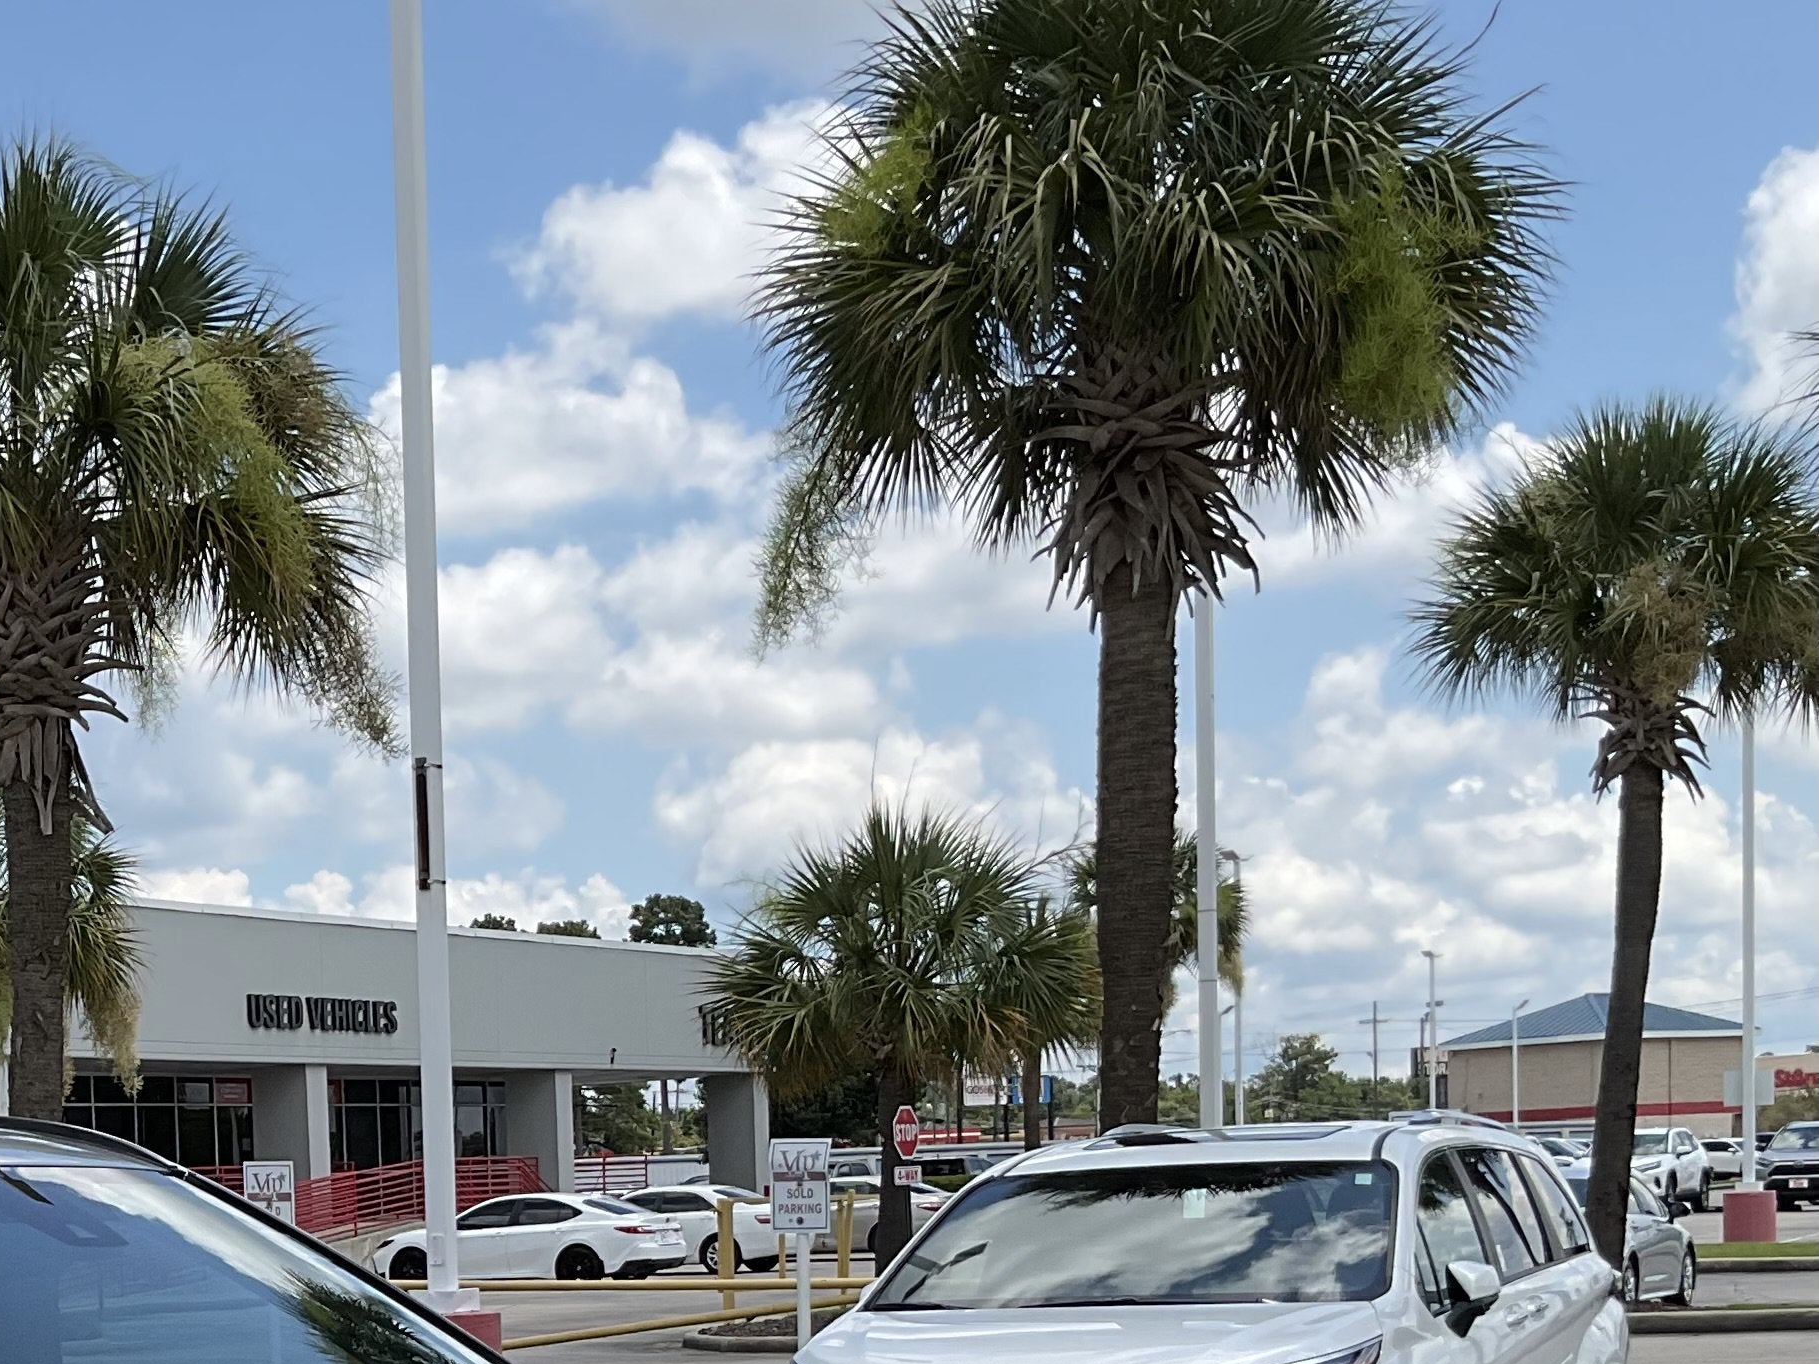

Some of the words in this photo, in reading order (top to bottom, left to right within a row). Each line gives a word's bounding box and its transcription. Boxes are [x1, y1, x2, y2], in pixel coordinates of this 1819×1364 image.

[245, 993, 303, 1029] USED
[305, 996, 398, 1034] VEHICLES
[895, 1123, 917, 1142] STOP
[897, 1169, 919, 1181] 4-WAY
[786, 1188, 814, 1199] SOLD
[778, 1203, 822, 1214] PARKING
